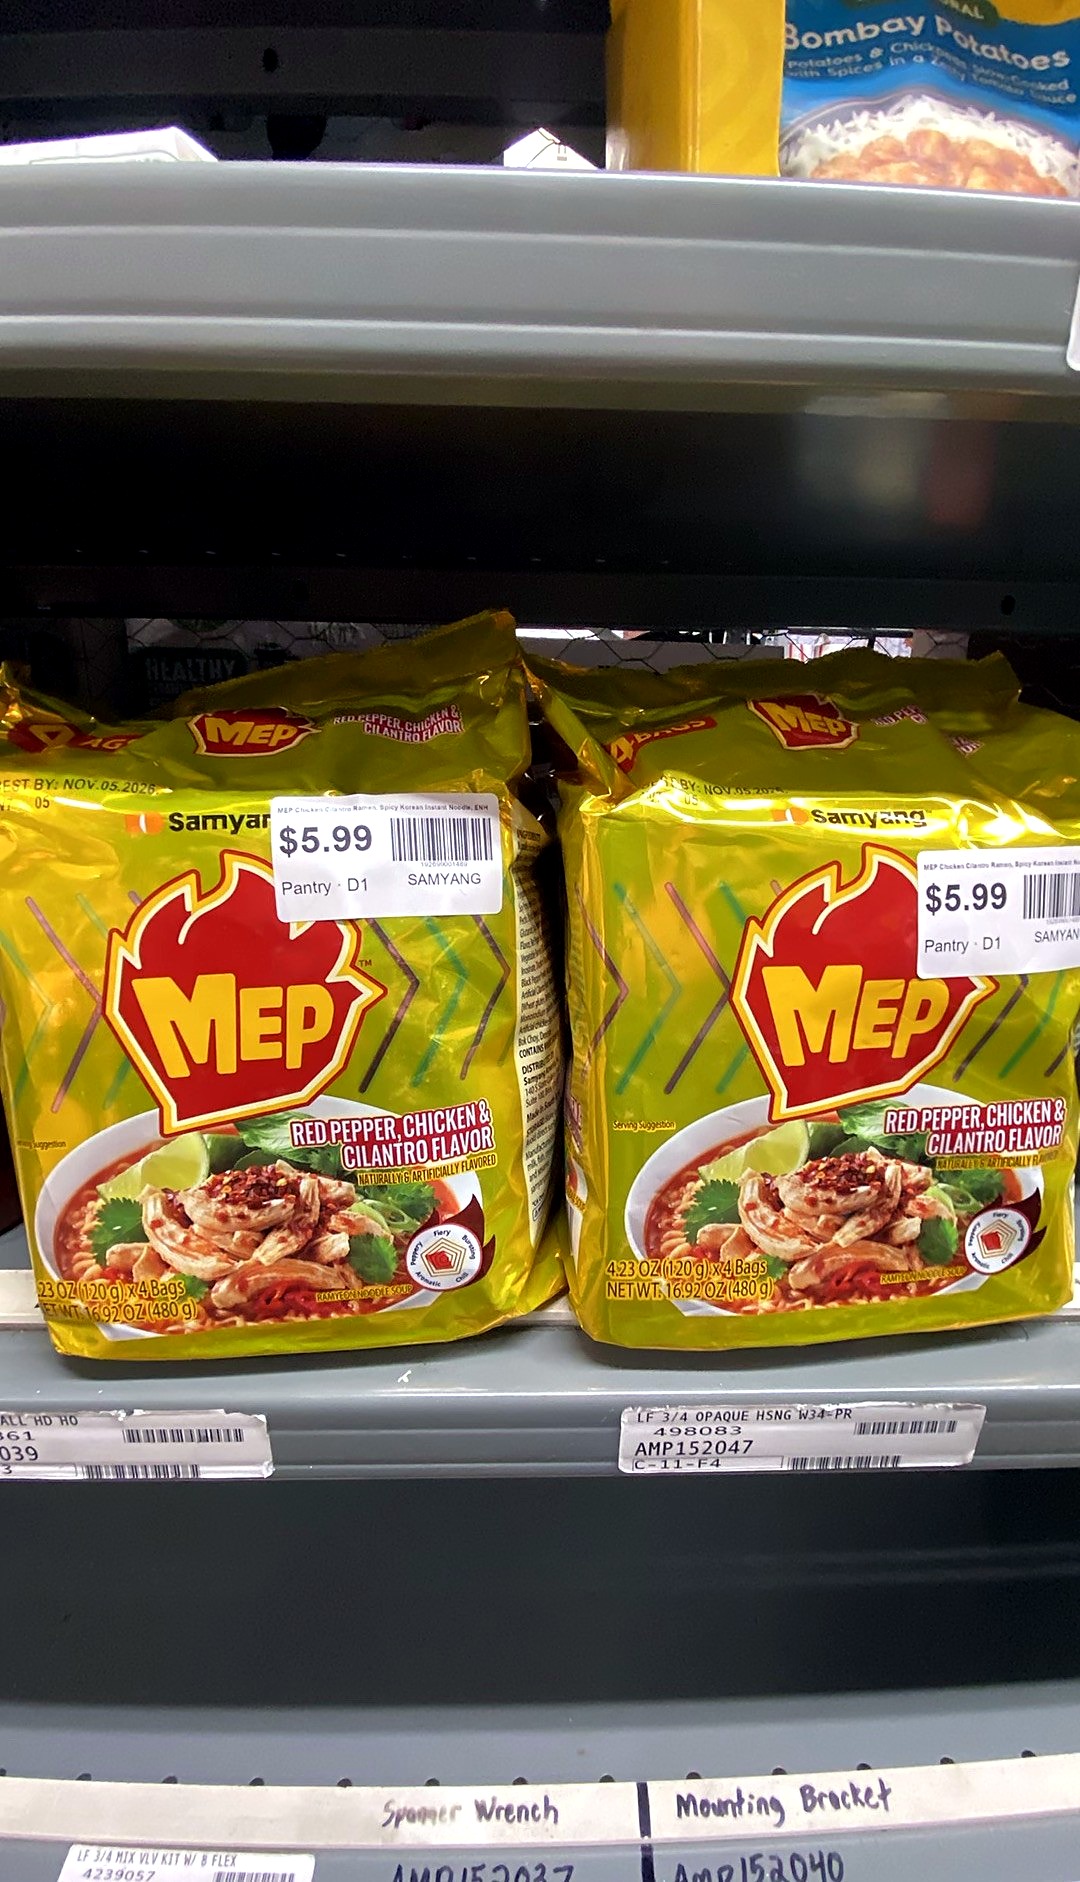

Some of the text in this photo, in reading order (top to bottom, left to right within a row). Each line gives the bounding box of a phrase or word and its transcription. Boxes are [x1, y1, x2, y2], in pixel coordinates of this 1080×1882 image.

[785, 14, 1070, 71] Bombay Potatoes
[788, 53, 862, 68] Potatoes
[827, 61, 882, 77] Spices
[404, 708, 449, 732] CHICKEN
[759, 702, 846, 736] MEP
[205, 717, 297, 746] MEP
[364, 719, 460, 742] CILANTRO FLAVOR
[0, 779, 30, 792] EST
[169, 812, 271, 835] Samya
[811, 809, 927, 828] Samyang
[280, 825, 372, 857] $5.99
[282, 878, 368, 896] Pantry D1
[408, 873, 481, 886] SAMYANG
[926, 883, 1007, 916] $5.99
[924, 937, 1001, 955] Pantry D1
[1034, 929, 1080, 943] SAMYAN
[131, 973, 335, 1079] MEP
[762, 965, 950, 1067] MEP
[291, 1100, 490, 1146] RED PEPPER, CHICKEN &
[885, 1099, 1065, 1133] RED PEPPER, CHICKEN &
[342, 1139, 427, 1168] CILANTRO
[432, 1126, 492, 1165] FLAVOR
[928, 1124, 1062, 1154] CILANTRO FLAVOR
[358, 1174, 401, 1186] NATURALLY
[412, 1165, 459, 1182] ARTIFICIALLY
[461, 1154, 496, 1173] FLAVORED
[433, 1229, 451, 1238] Fiery
[415, 1271, 441, 1287] Aromatic
[607, 1260, 766, 1281] 4.23 OZ (120 g) x 4 Bags
[37, 1281, 54, 1298] .23
[57, 1282, 76, 1299] OZ
[78, 1281, 106, 1302] (120
[110, 1281, 124, 1304] g)
[139, 1283, 148, 1298] 4
[151, 1280, 185, 1297] Bags
[607, 1280, 773, 1300] NET WT. 16.92 OZ (480 g)
[43, 1303, 57, 1317] ET
[123, 1304, 144, 1320] OZ
[148, 1302, 179, 1321] (480
[183, 1301, 197, 1321] g)
[33, 1415, 53, 1426] HD
[59, 1415, 78, 1426] HO
[638, 1411, 652, 1424] LF
[664, 1410, 688, 1423] 3/4
[695, 1410, 750, 1423] OPAQUE
[756, 1409, 792, 1421] HSNG
[654, 1425, 742, 1438] 498083
[0, 1446, 38, 1461] 039
[635, 1440, 753, 1456] AMP152047
[634, 1458, 722, 1471] C-11-F4
[474, 1794, 559, 1825] Wrench
[676, 1777, 892, 1827] Mounting Bracket
[77, 1850, 90, 1861] LF
[94, 1850, 112, 1863] 3/4
[116, 1851, 134, 1864] MIX
[140, 1852, 158, 1866] VLV
[161, 1853, 180, 1866] KIT
[212, 1855, 237, 1867] FLEX
[82, 1868, 156, 1882] 4239057
